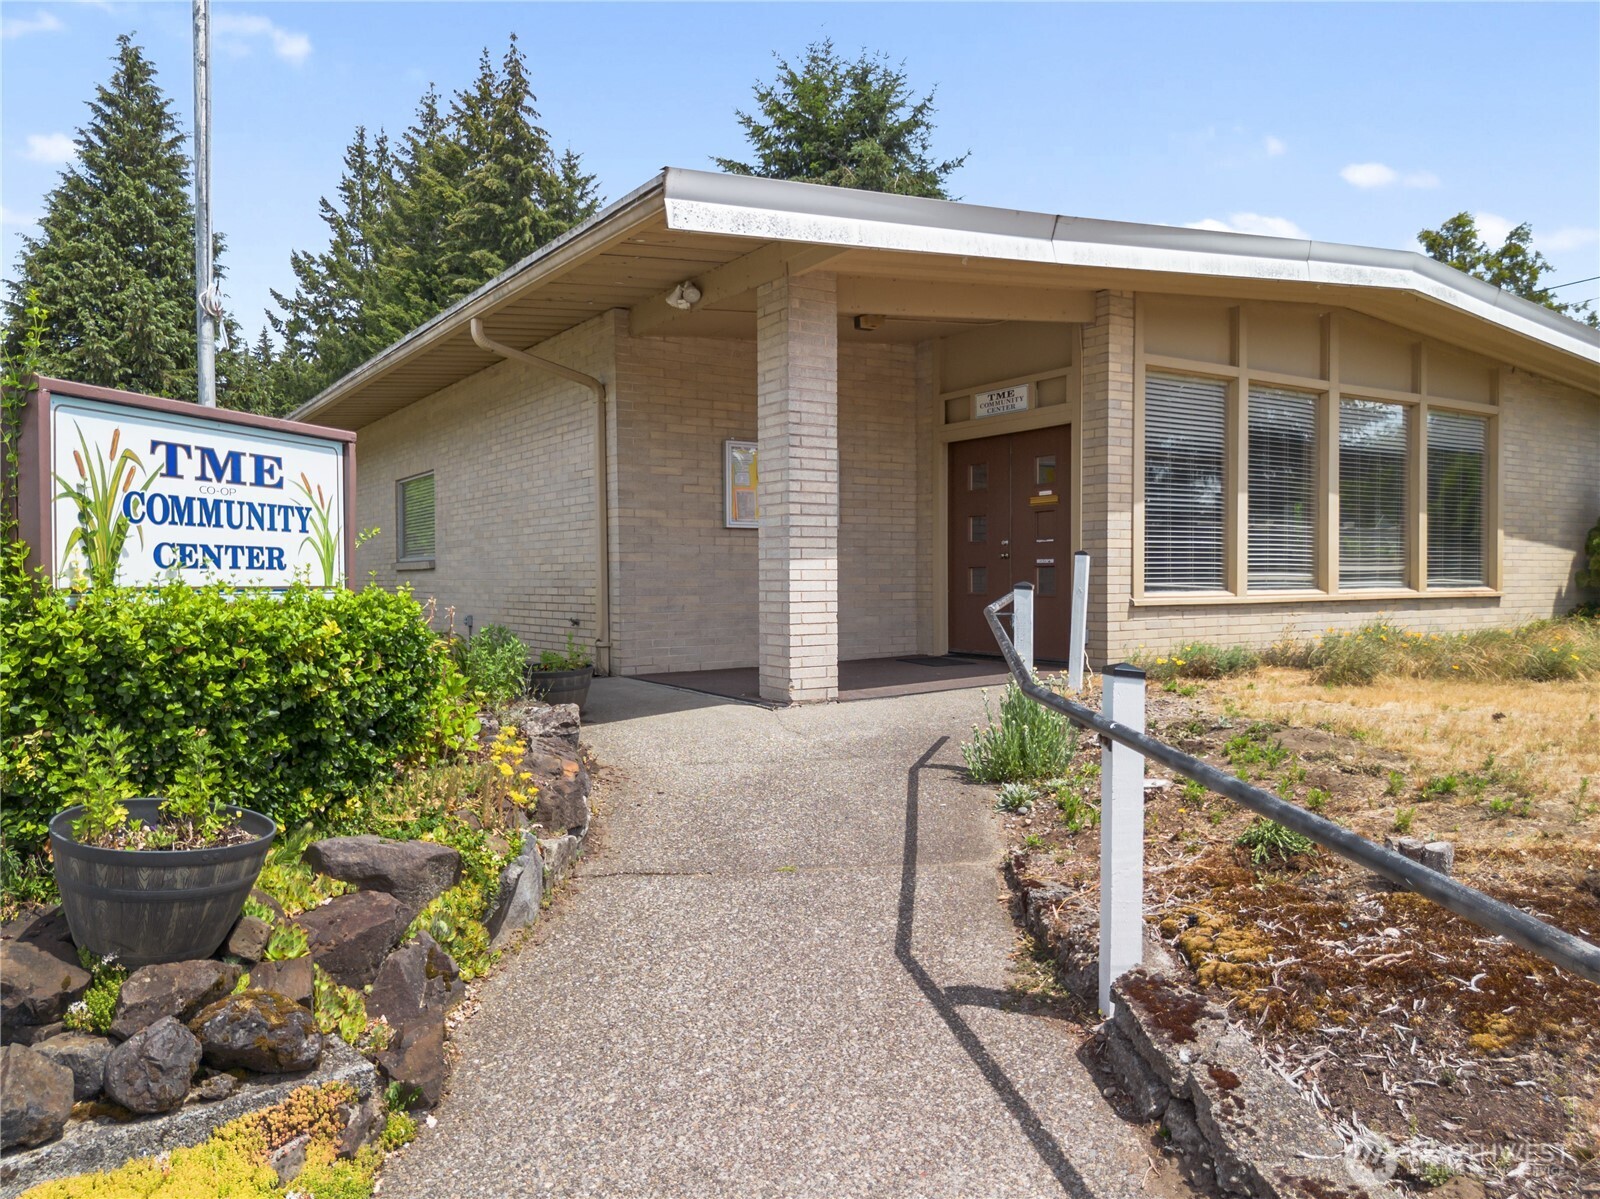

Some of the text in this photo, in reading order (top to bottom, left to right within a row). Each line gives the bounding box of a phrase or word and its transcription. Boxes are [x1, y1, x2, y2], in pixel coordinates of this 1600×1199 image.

[988, 390, 1015, 401] TME
[980, 396, 1024, 409] COMMUNITY
[987, 404, 1016, 413] CENTER
[150, 440, 284, 489] TME
[198, 485, 237, 495] CO-OP
[122, 491, 313, 534] COMMUNITY
[153, 542, 287, 571] CENTER
